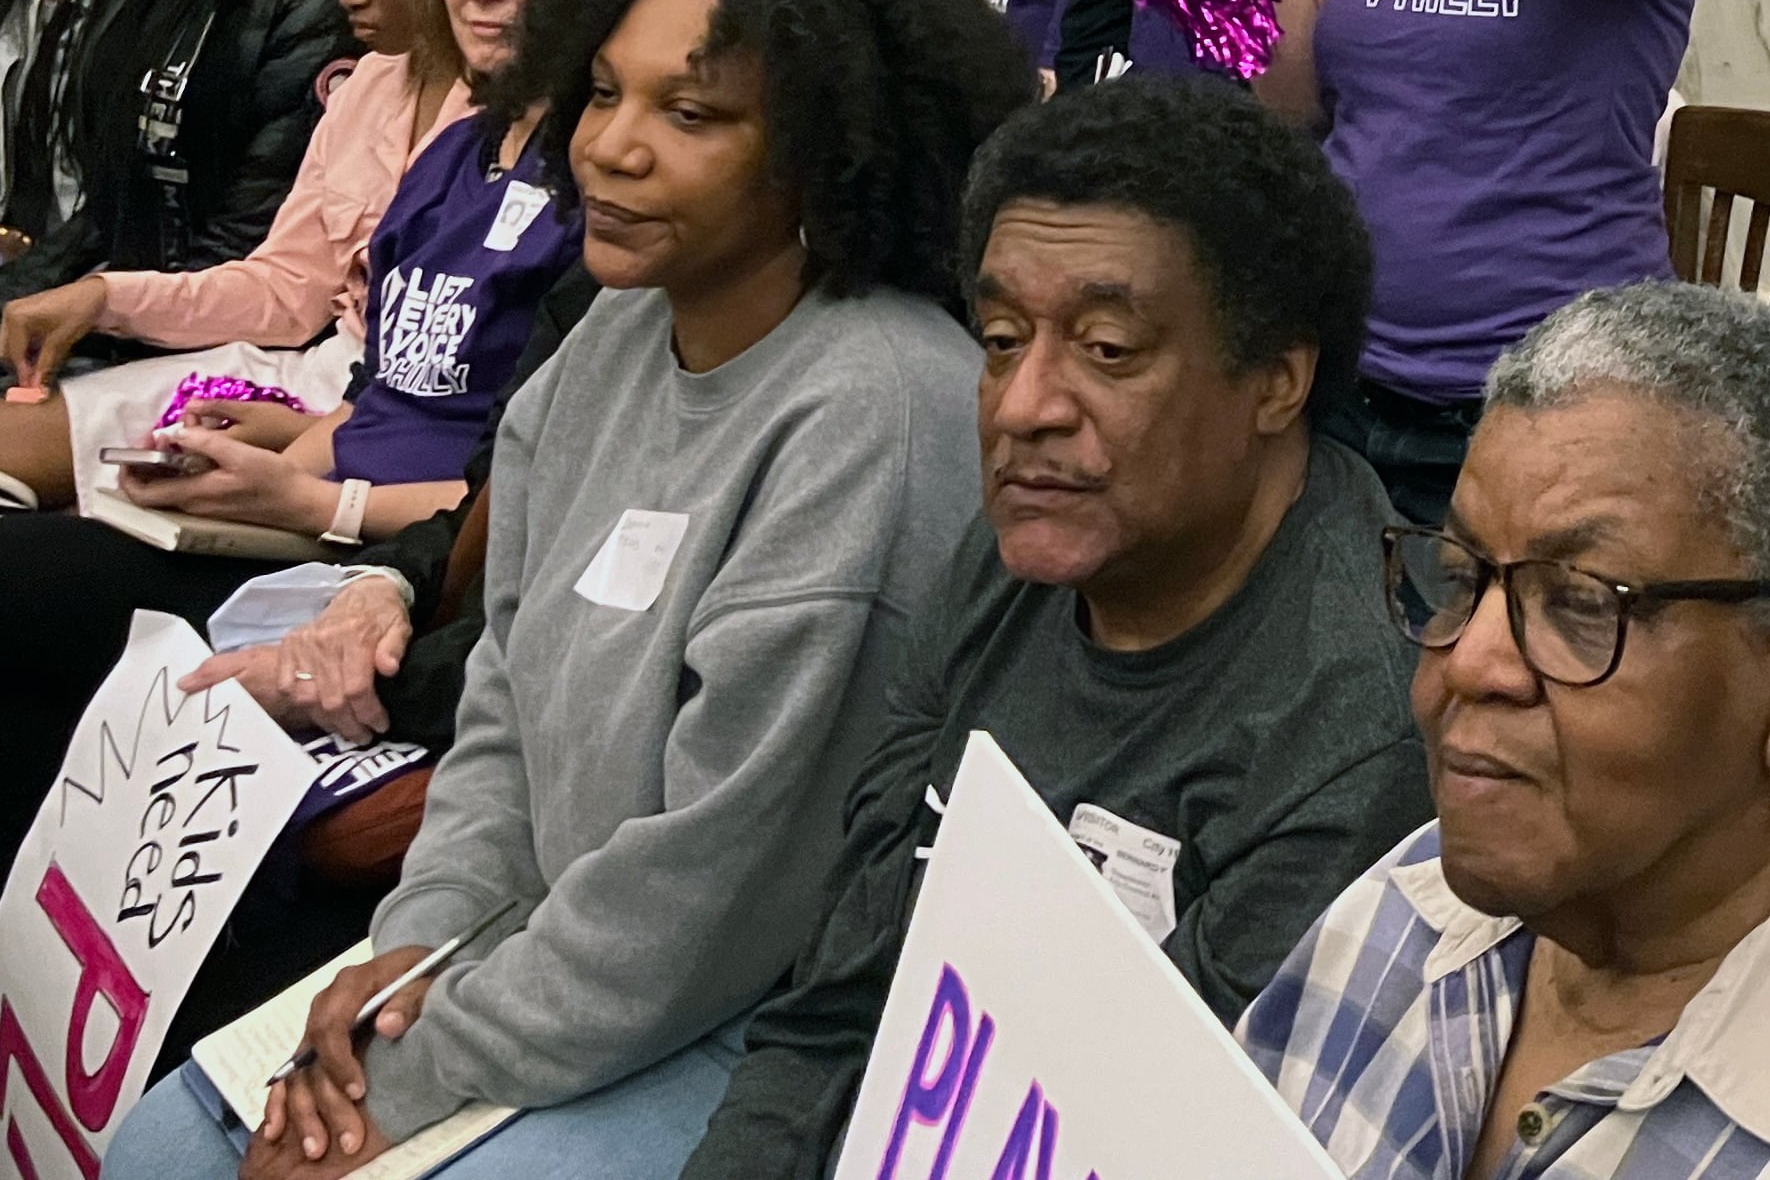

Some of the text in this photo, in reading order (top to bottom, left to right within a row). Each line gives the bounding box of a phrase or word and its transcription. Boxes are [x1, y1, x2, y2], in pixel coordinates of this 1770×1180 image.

[405, 266, 475, 306] LIFT
[396, 297, 477, 339] EVERY
[385, 326, 463, 366] VOICE
[116, 740, 200, 923] need
